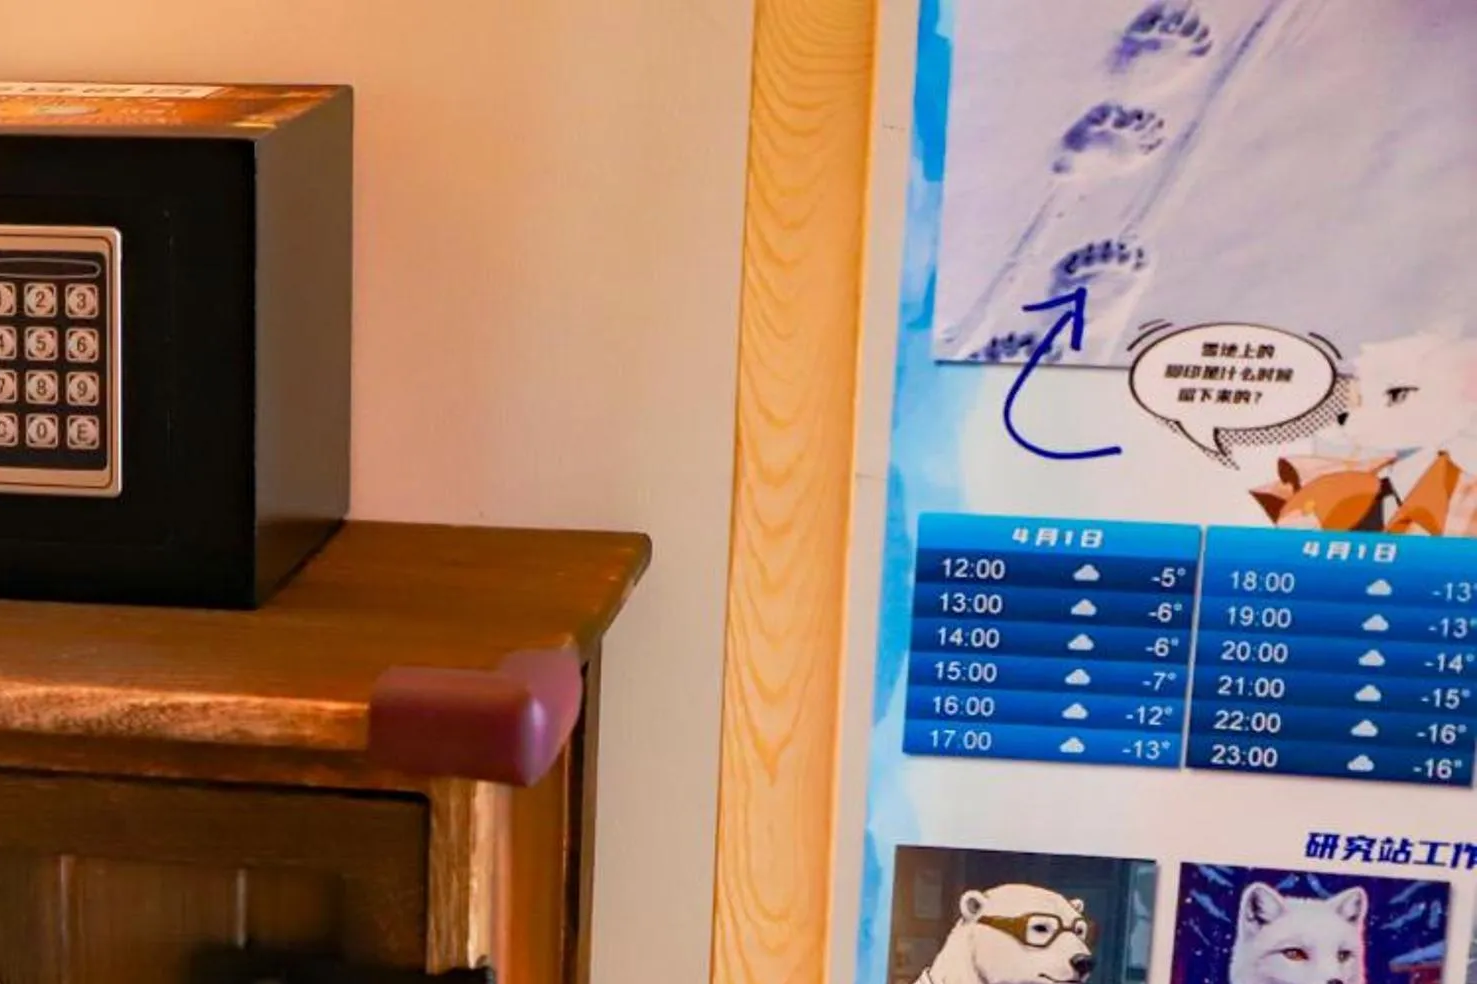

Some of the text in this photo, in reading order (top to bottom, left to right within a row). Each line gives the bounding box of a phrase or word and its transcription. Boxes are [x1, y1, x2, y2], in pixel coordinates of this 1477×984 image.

[35, 290, 46, 308] 2
[76, 292, 87, 309] 3
[35, 334, 46, 352] 5
[76, 336, 87, 353] 6
[35, 379, 47, 396] 8
[76, 380, 87, 397] 9
[76, 423, 87, 441] E
[1012, 527, 1103, 548] 4月1日
[1302, 540, 1397, 563] 4月1日
[942, 558, 1005, 580] 12:00
[1230, 571, 1295, 593] 18:00
[939, 593, 1003, 614] 13:00
[1227, 605, 1292, 629] 19:00
[937, 627, 1000, 649] 14:00
[1221, 641, 1289, 663] 20:00
[934, 661, 998, 683] 15:00
[1217, 675, 1285, 698] 21:00
[933, 695, 995, 717] 16:00
[1213, 710, 1282, 733] 22:00
[929, 730, 992, 750] 17:00
[1211, 744, 1279, 768] 23:00
[1305, 831, 1477, 870] 研究站工作
